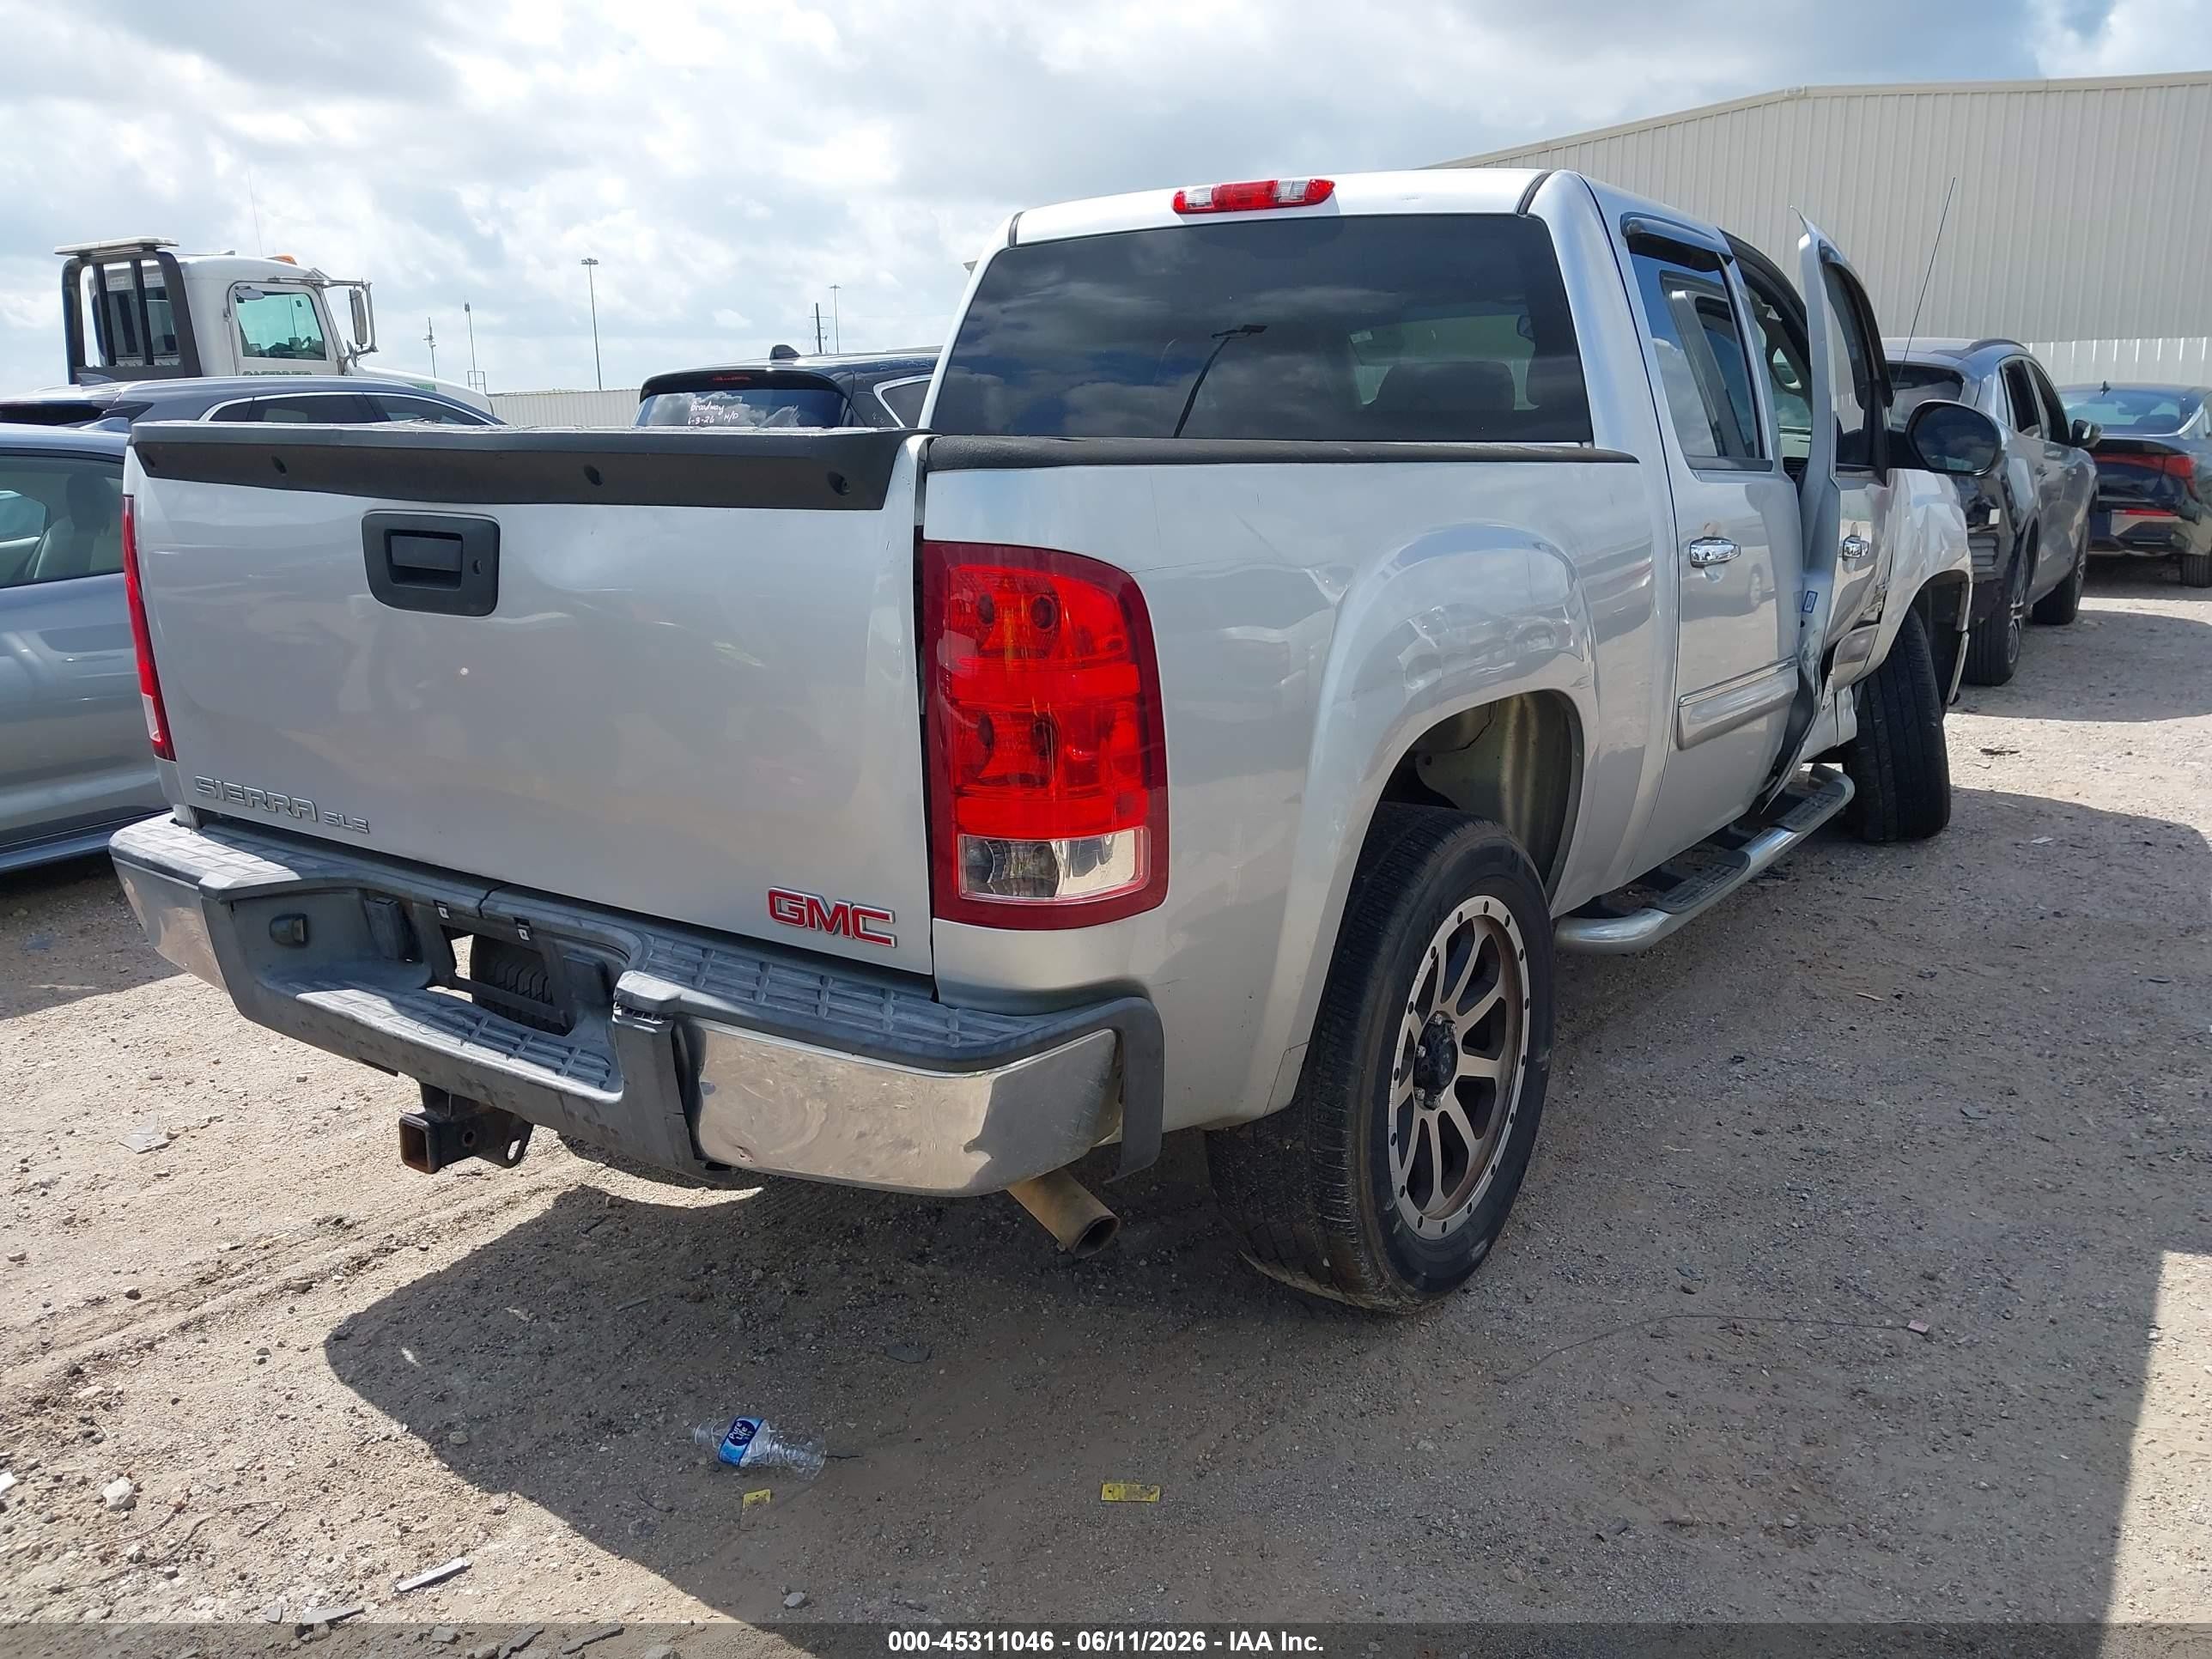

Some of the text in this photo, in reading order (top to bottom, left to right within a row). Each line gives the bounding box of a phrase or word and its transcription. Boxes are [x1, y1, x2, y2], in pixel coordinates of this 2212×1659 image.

[193, 775, 370, 834] SIERRA SLE
[768, 886, 897, 948] GMC
[728, 1422, 743, 1440] Pure
[736, 1426, 748, 1440] Life
